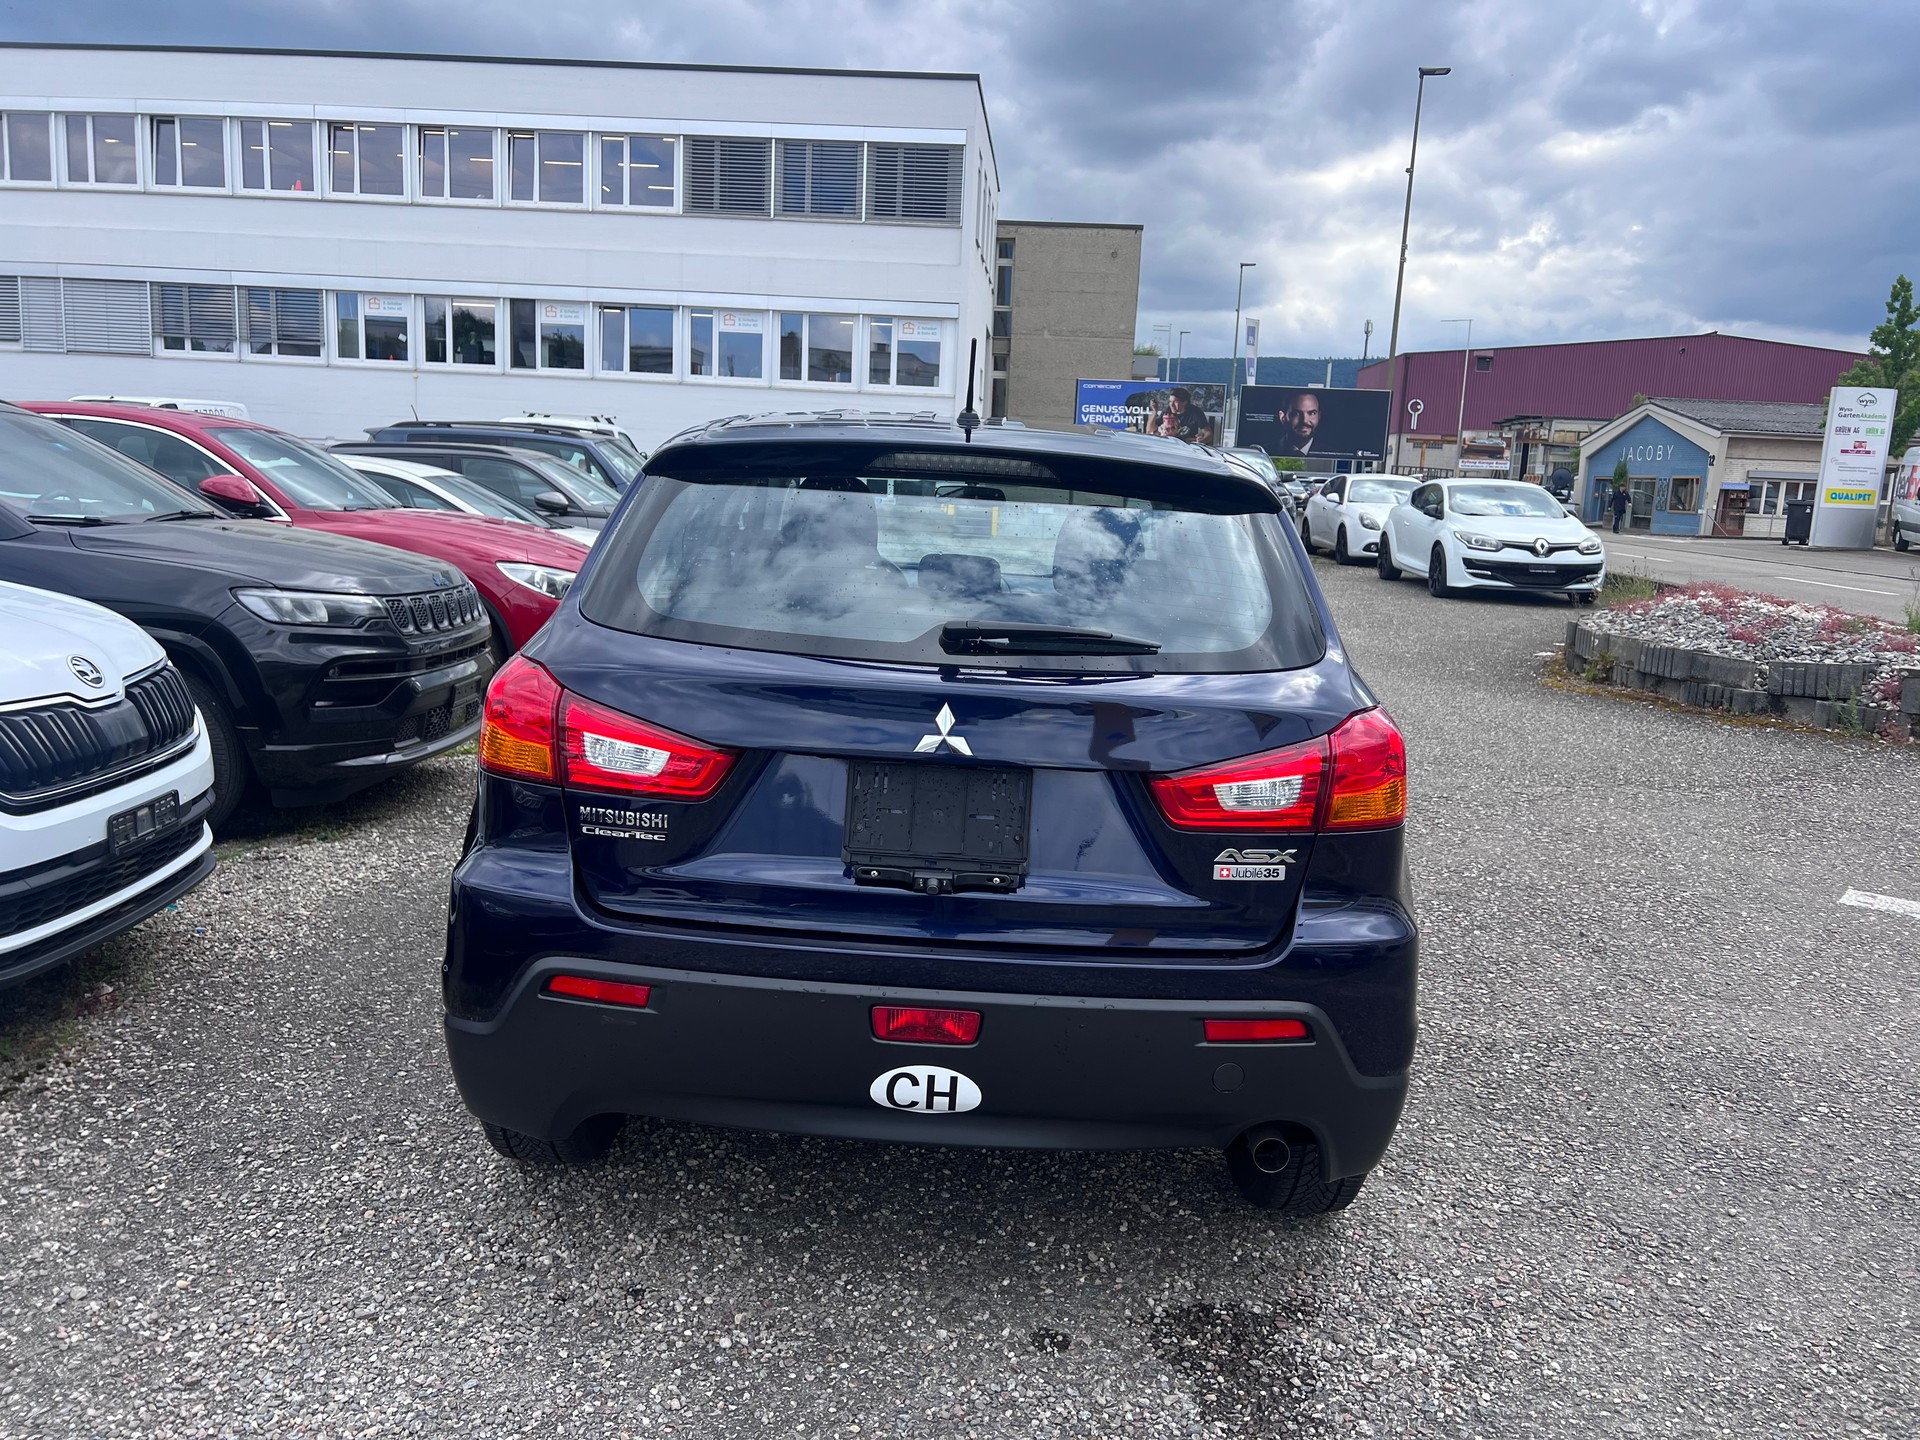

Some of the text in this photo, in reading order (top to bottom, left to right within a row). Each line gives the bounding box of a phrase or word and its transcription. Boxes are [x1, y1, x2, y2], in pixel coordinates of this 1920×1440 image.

[1082, 405, 1152, 415] GENUSSVOLL
[1838, 412, 1887, 420] GartenAkademie
[1081, 414, 1144, 424] VERWÖHNT.
[1620, 444, 1674, 462] JACOBY
[1708, 454, 1715, 467] 12
[1830, 492, 1872, 502] QUALIPET
[580, 806, 668, 828] MITSUBISHI
[582, 826, 666, 841] ClearTec
[1213, 848, 1298, 863] ASX
[886, 1072, 958, 1111] CH
